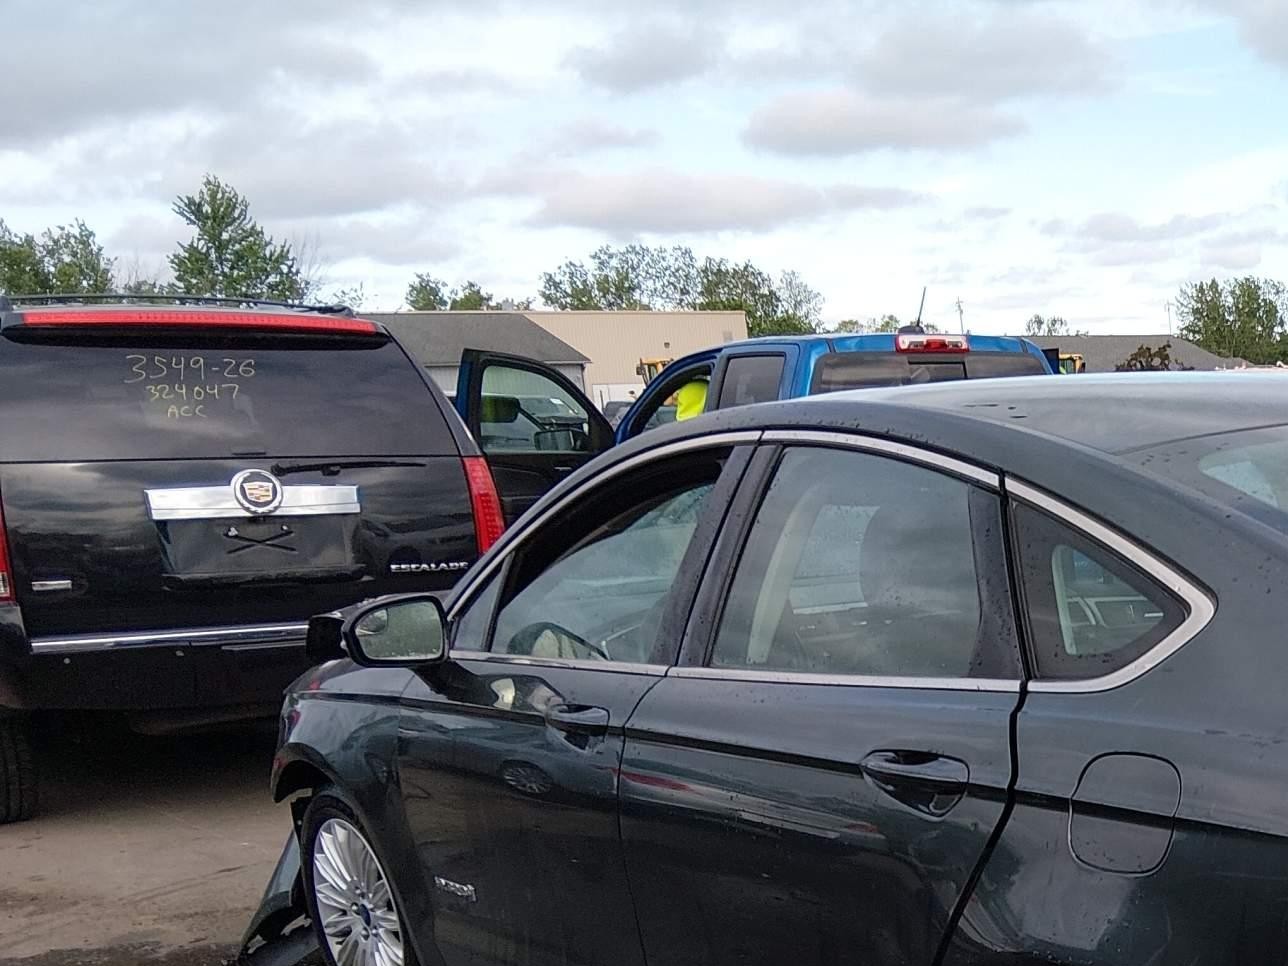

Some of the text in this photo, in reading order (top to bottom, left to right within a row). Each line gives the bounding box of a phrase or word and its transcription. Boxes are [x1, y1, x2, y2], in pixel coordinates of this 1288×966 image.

[124, 354, 256, 383] 3549-26
[145, 383, 239, 401] 324047
[167, 404, 207, 418] ACC
[390, 561, 469, 573] ESCALADE
